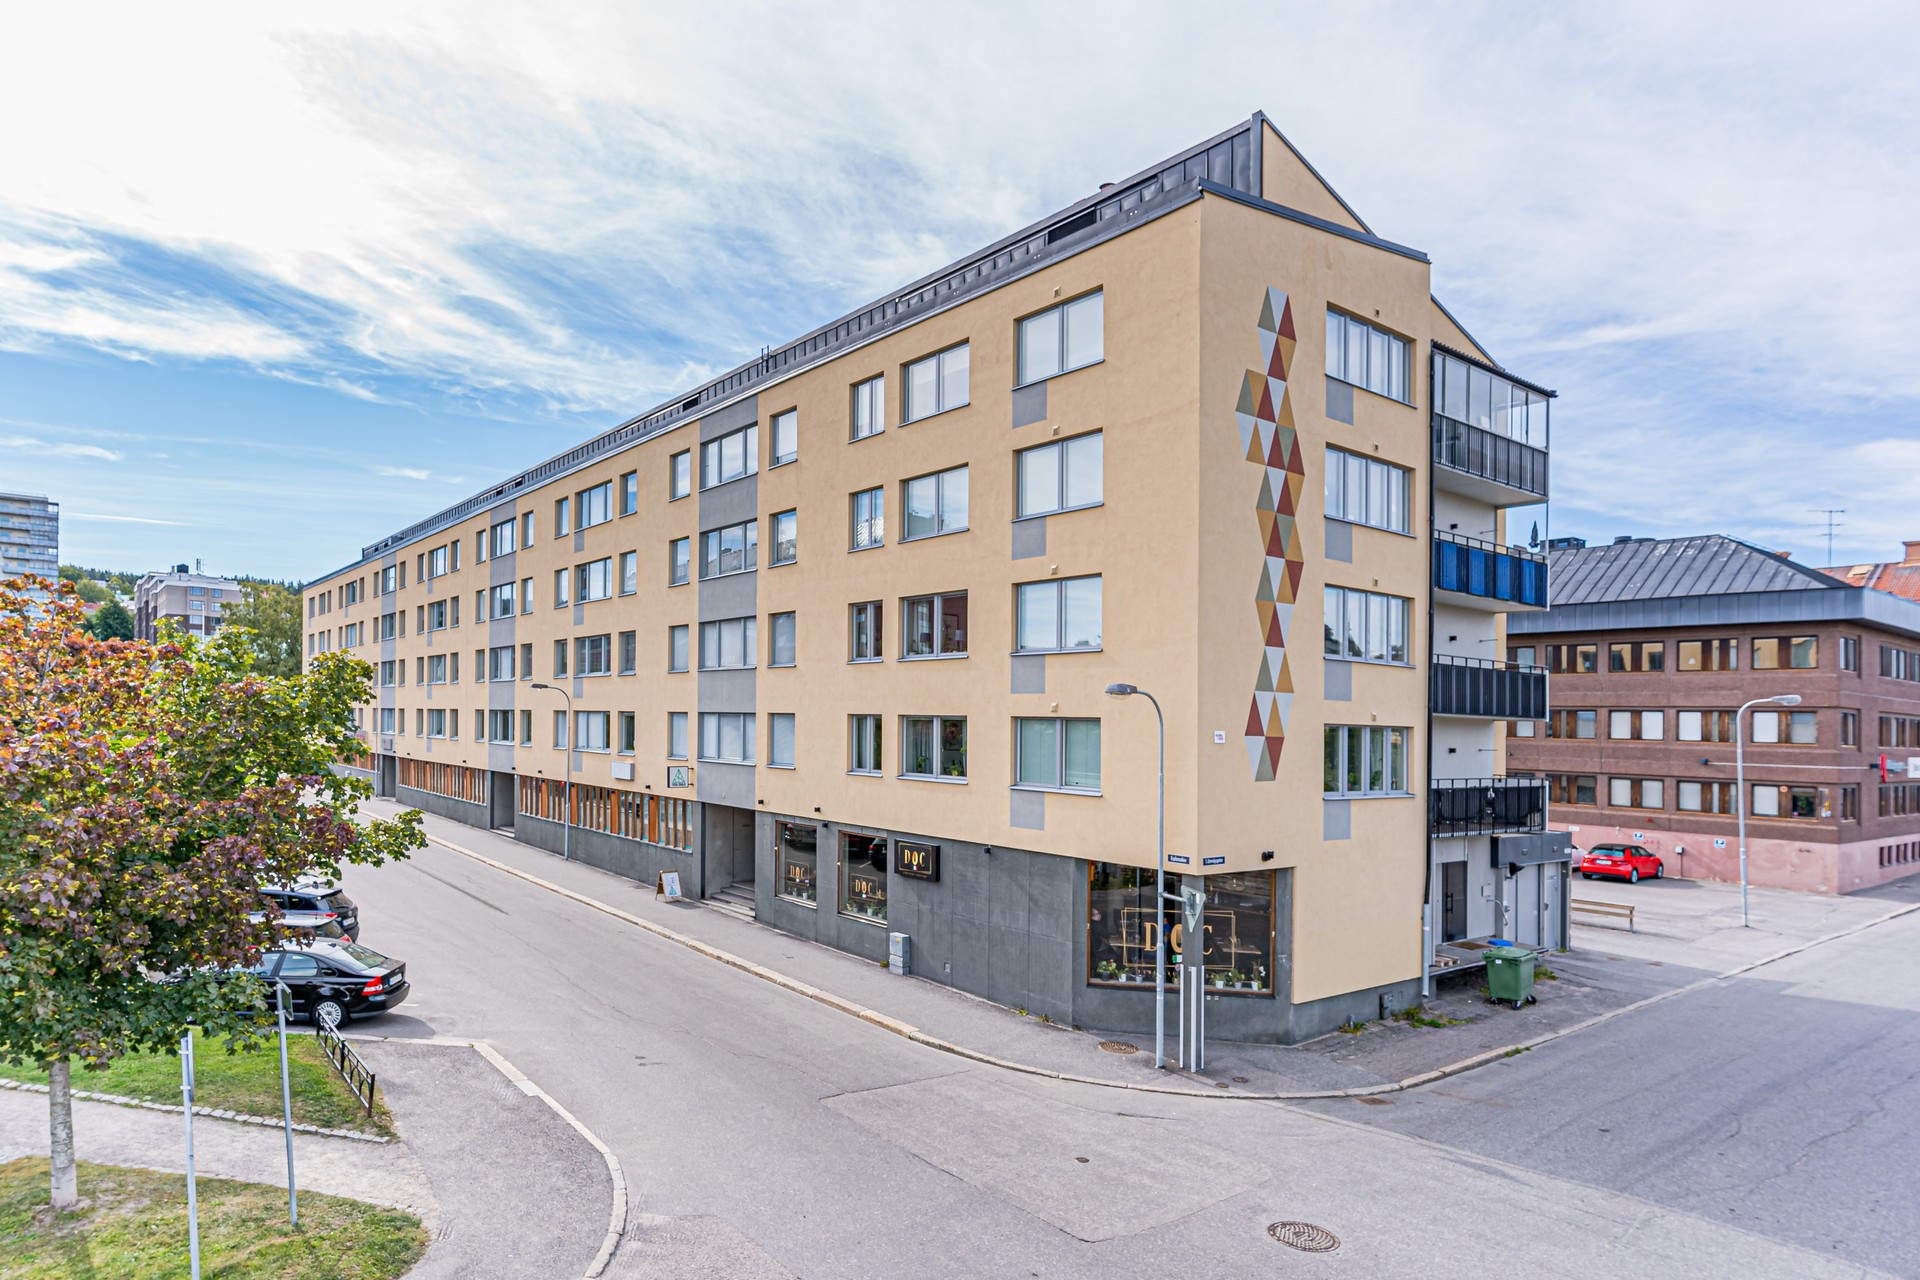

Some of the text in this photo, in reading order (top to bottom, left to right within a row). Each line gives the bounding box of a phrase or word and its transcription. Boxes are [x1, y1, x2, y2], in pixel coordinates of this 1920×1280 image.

[904, 849, 926, 867] DOC
[790, 865, 805, 879] DOC
[855, 879, 873, 896] DOC
